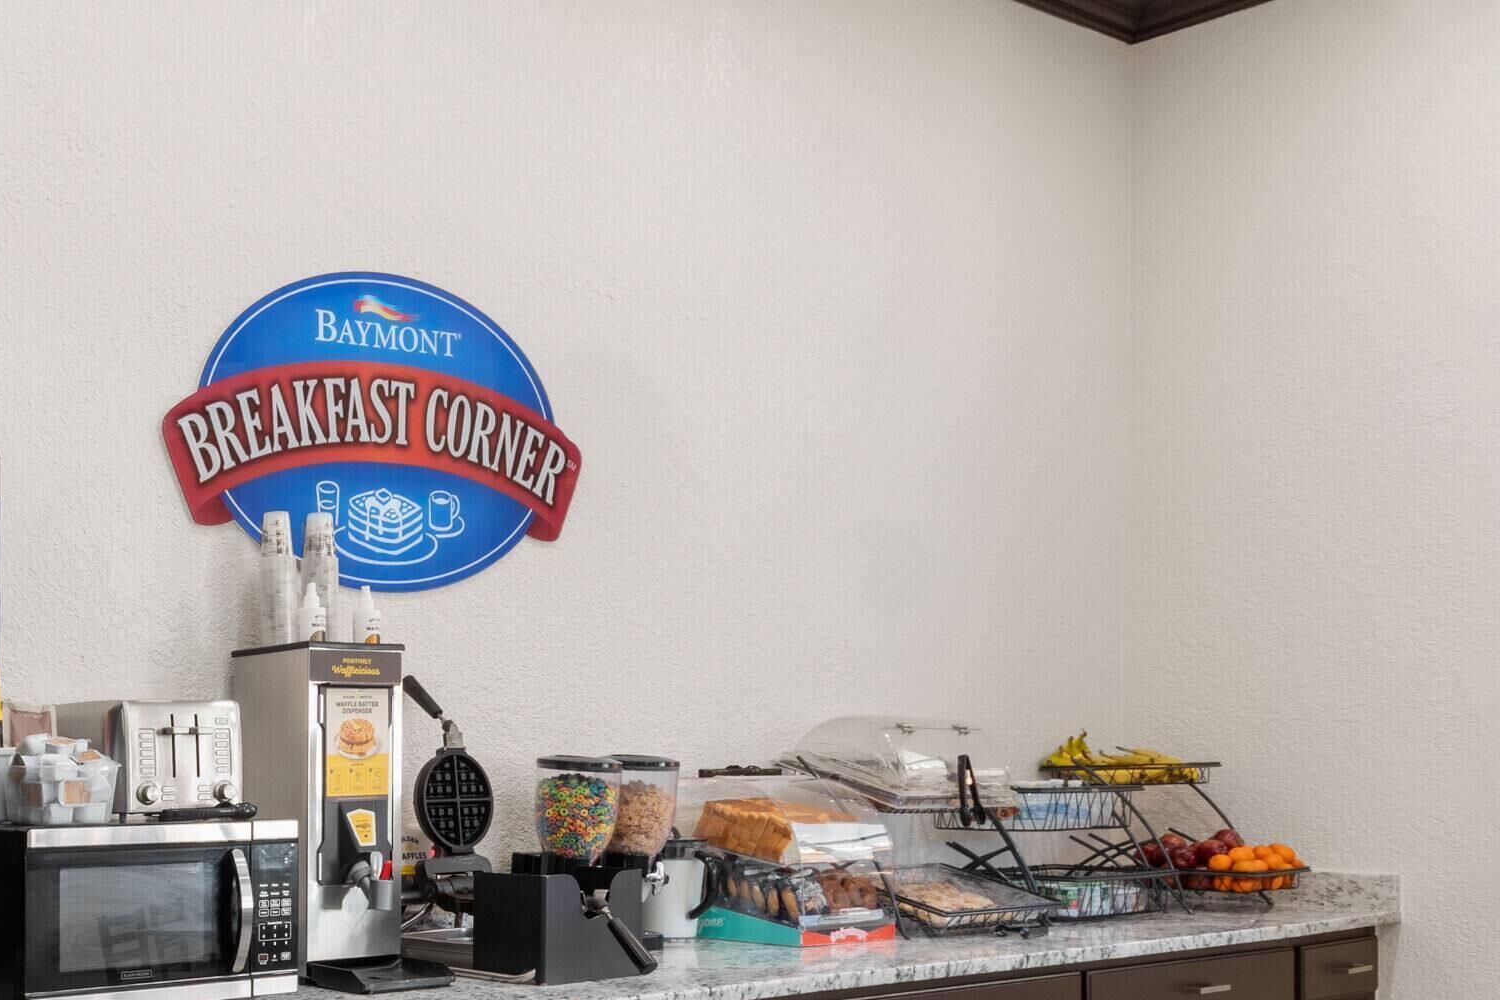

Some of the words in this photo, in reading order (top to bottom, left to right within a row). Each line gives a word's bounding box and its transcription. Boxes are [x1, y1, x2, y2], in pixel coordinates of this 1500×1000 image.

[314, 308, 457, 357] BAYMONT
[177, 377, 415, 484] BREAKFAST
[425, 387, 566, 506] CORNER
[402, 852, 427, 861] AFFLES
